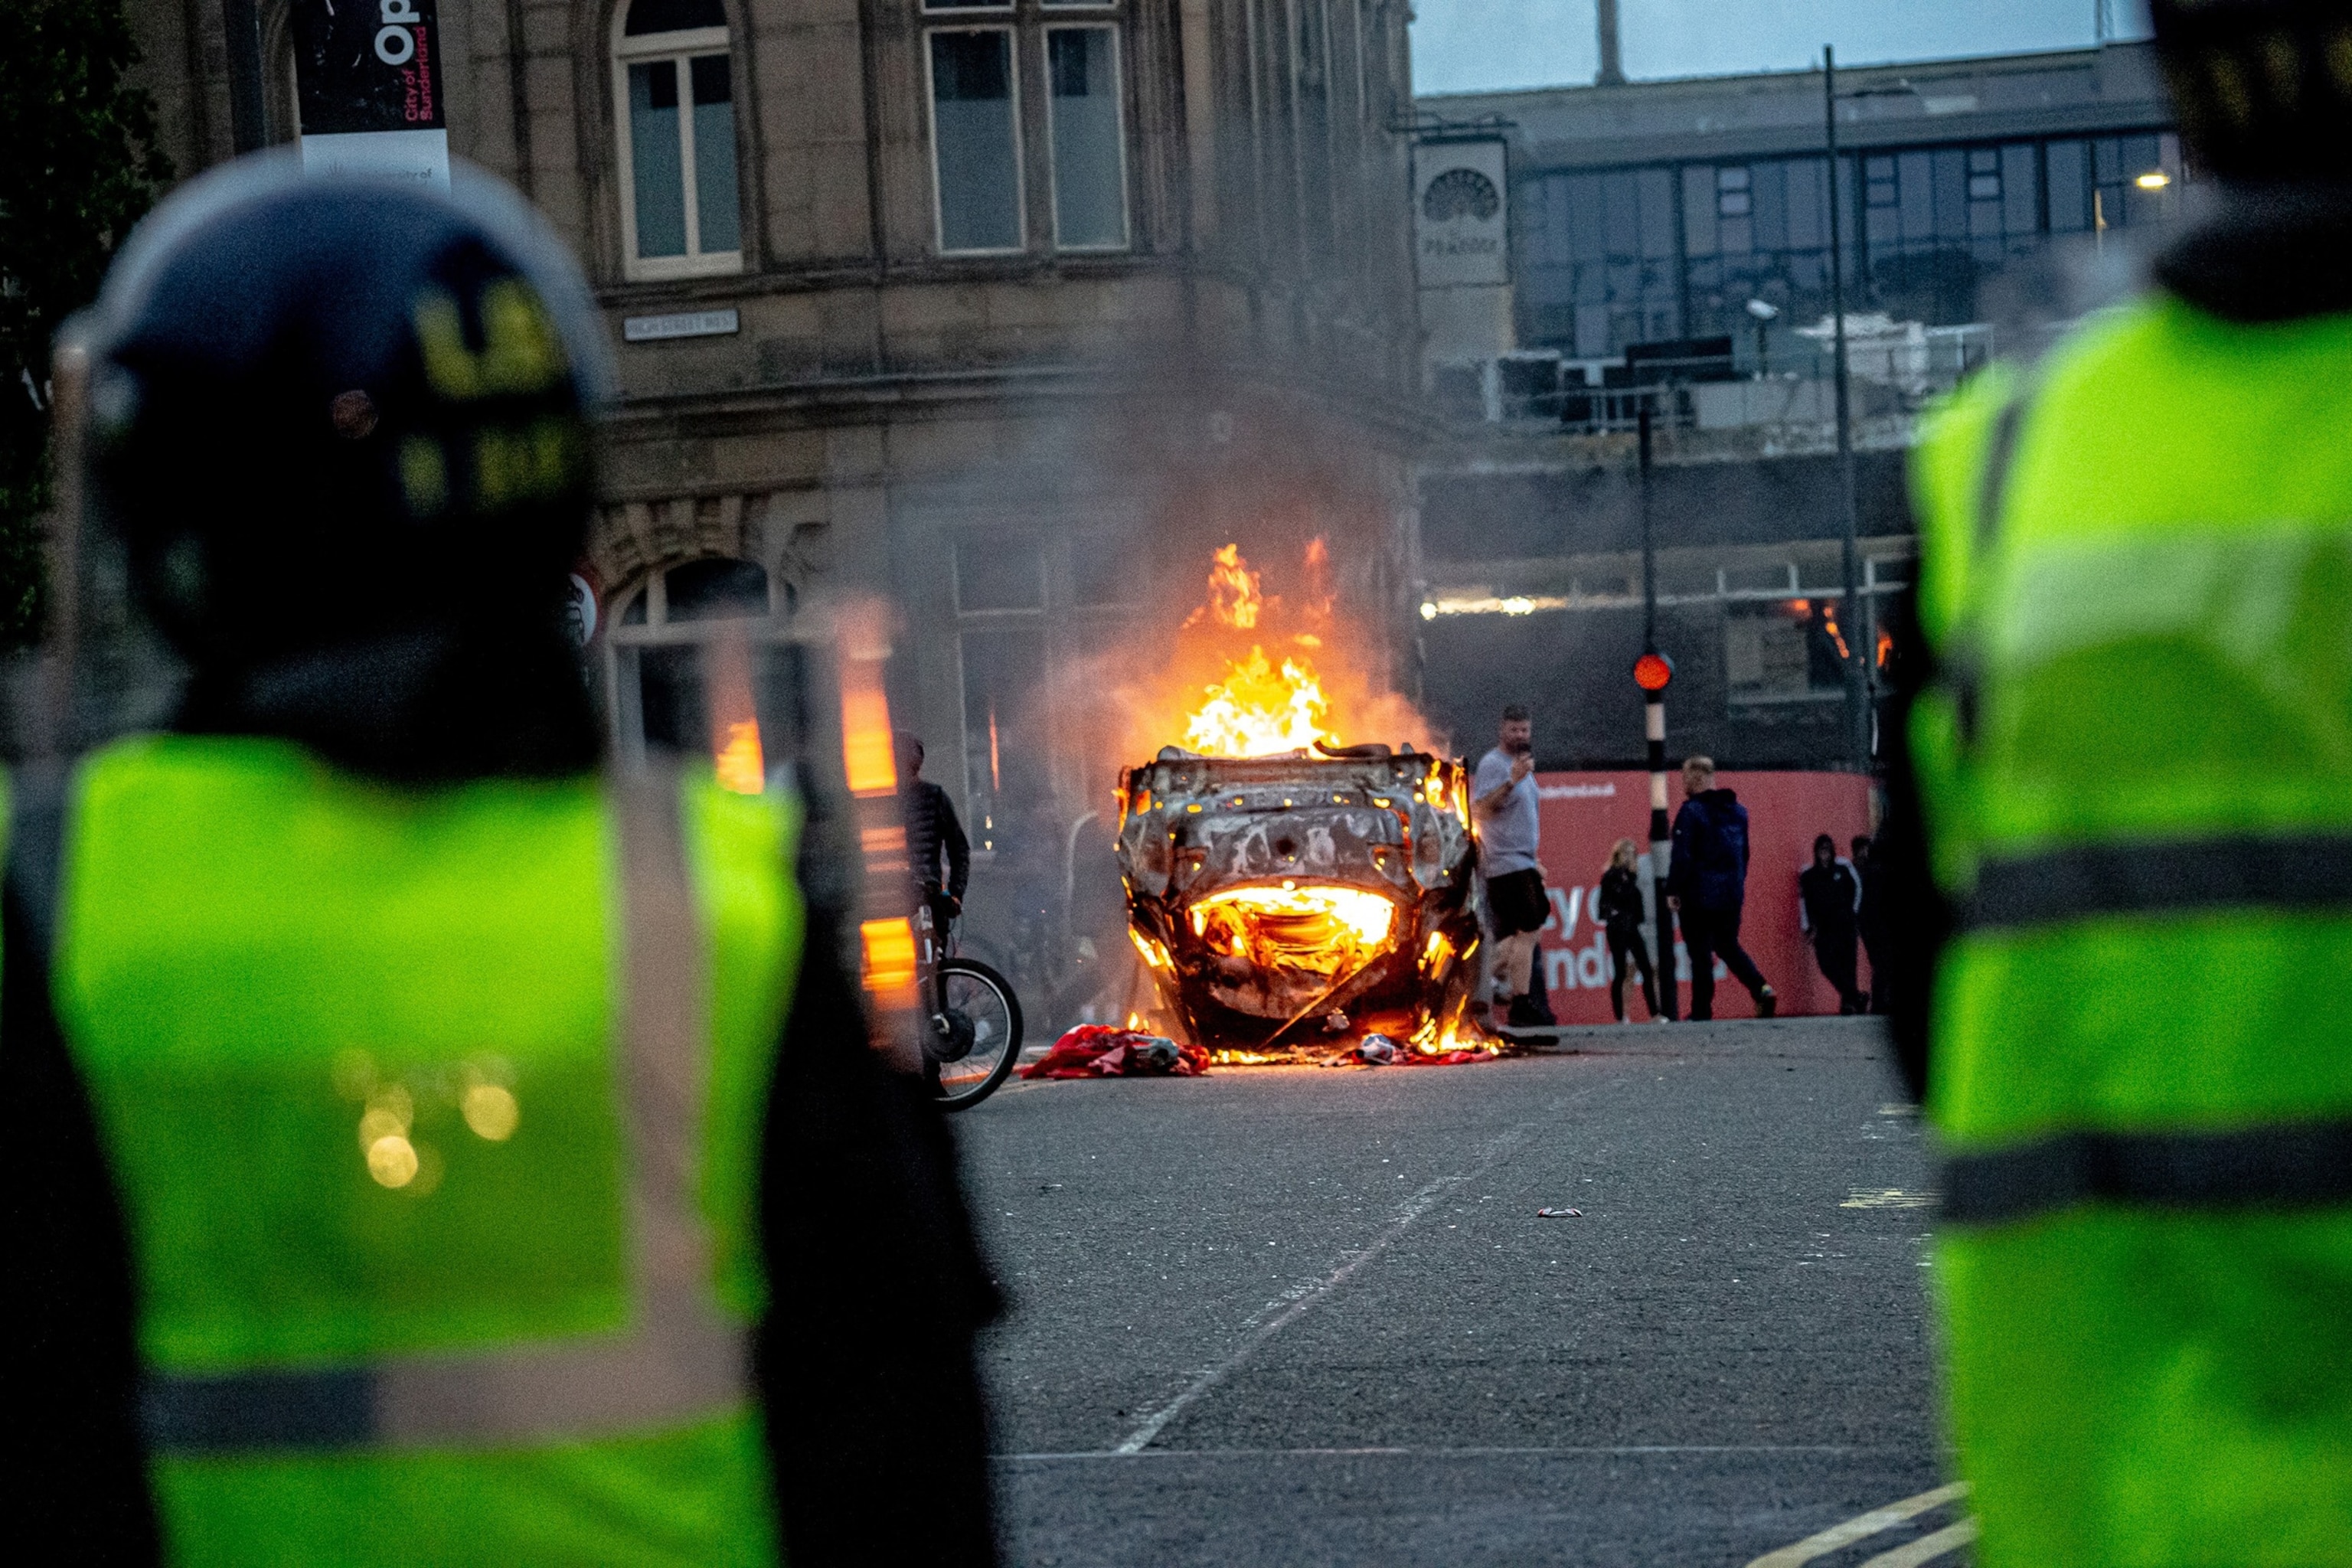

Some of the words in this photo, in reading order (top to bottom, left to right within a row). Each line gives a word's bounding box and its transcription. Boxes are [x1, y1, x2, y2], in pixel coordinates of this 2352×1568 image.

[403, 69, 416, 86] of
[413, 26, 433, 121] Sunderland
[404, 87, 419, 121] City
